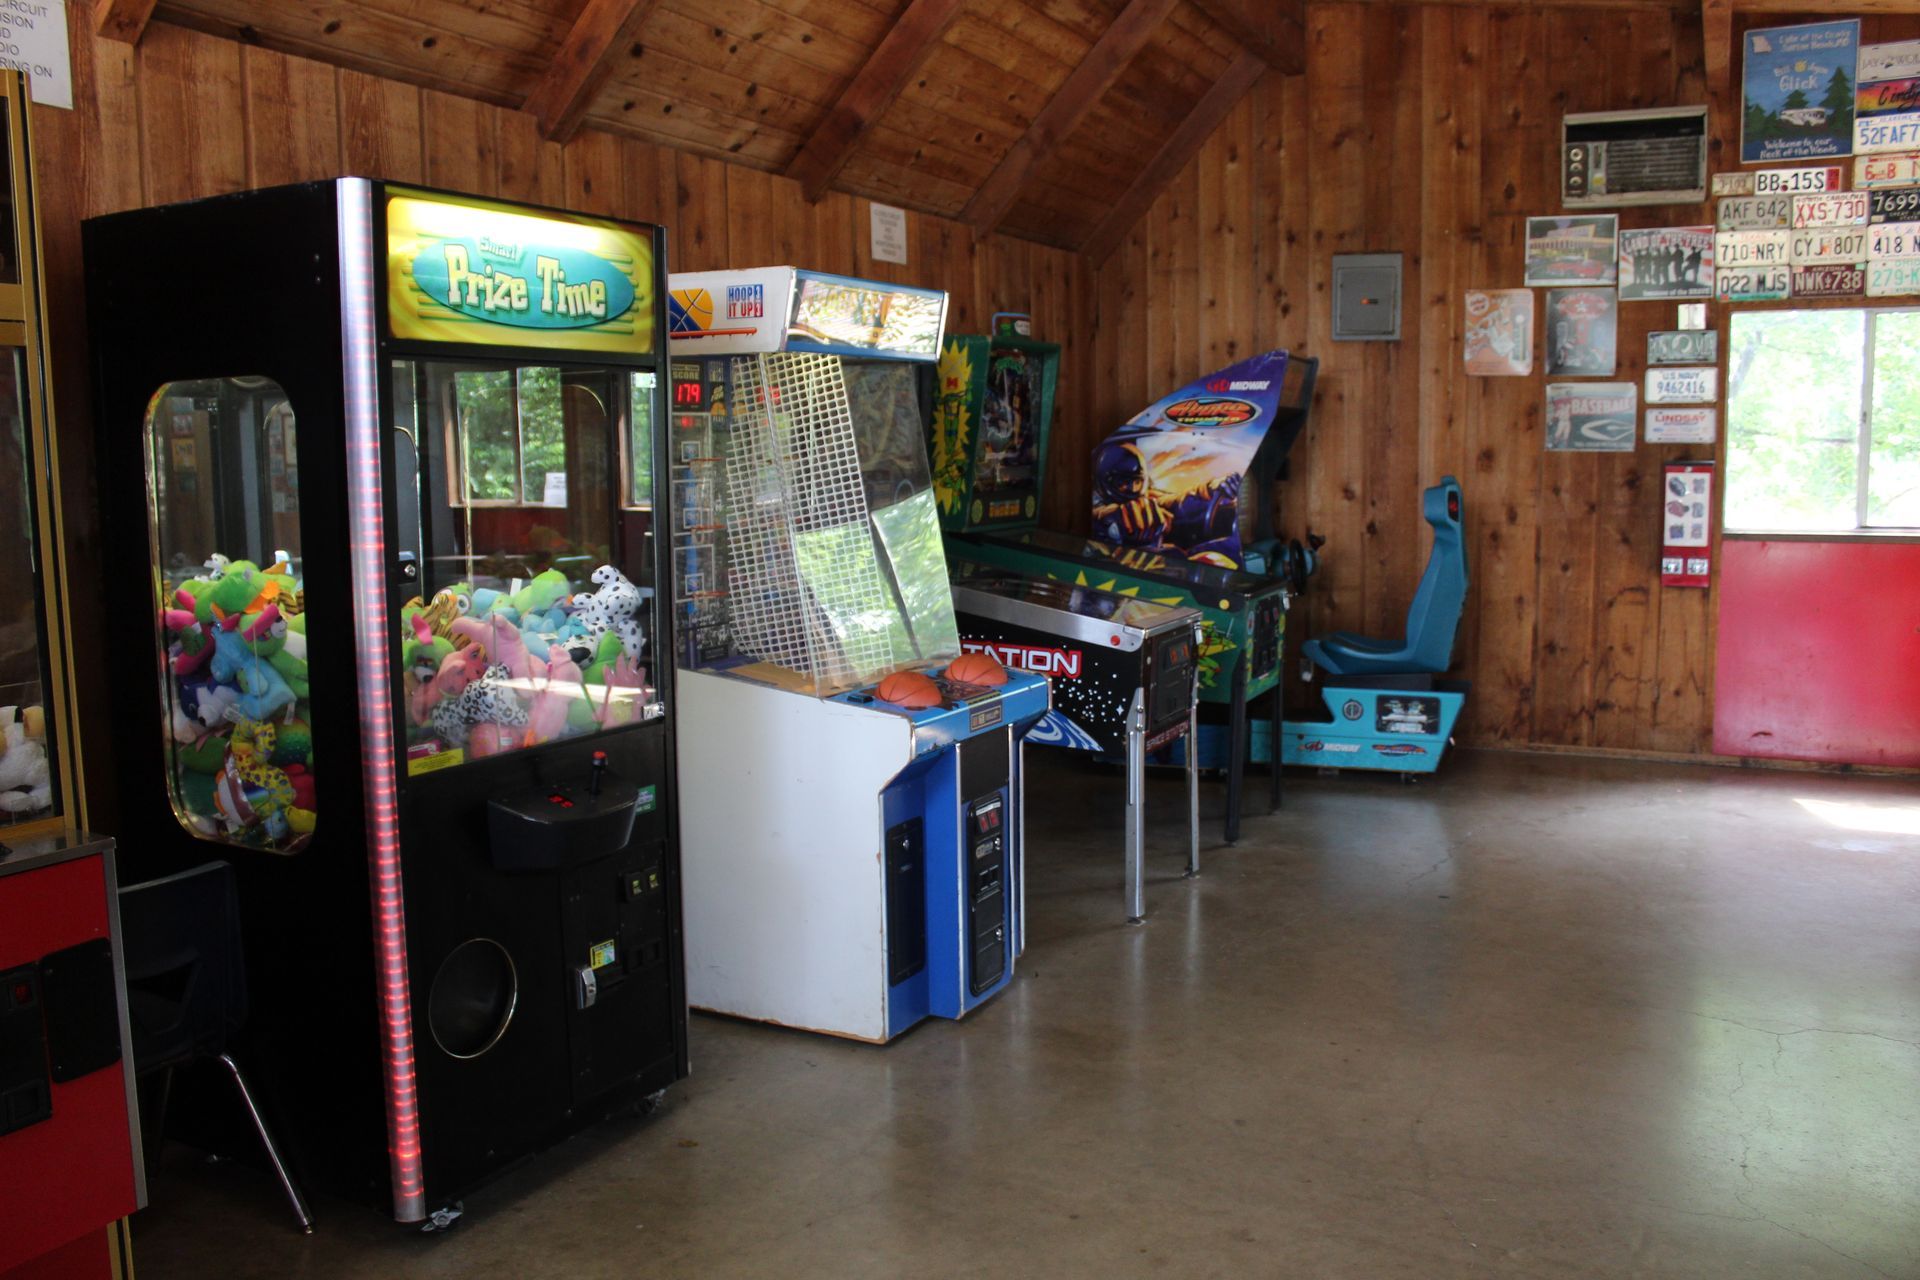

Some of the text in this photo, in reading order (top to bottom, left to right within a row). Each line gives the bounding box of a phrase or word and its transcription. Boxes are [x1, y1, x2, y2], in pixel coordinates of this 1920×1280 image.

[0, 0, 48, 17] IRCUIT
[34, 64, 53, 78] ON
[1779, 74, 1818, 92] Glick
[1723, 199, 1788, 219] AKF 642
[1720, 242, 1785, 262] 710 NRY
[1793, 235, 1864, 257] CYJ 807
[1873, 235, 1903, 254] 418
[443, 243, 606, 319] Prize Time
[1757, 273, 1787, 292] MJS
[1795, 270, 1862, 291] NWK 738
[728, 286, 753, 302] HOOP
[728, 302, 738, 318] IT
[740, 301, 753, 317] UP
[672, 371, 699, 380] SCORE
[677, 383, 701, 403] 179
[1229, 380, 1271, 391] MIDWAY
[1657, 381, 1705, 394] 9462416
[1571, 398, 1633, 416] BASEBALL
[1655, 414, 1706, 423] LINDSAY
